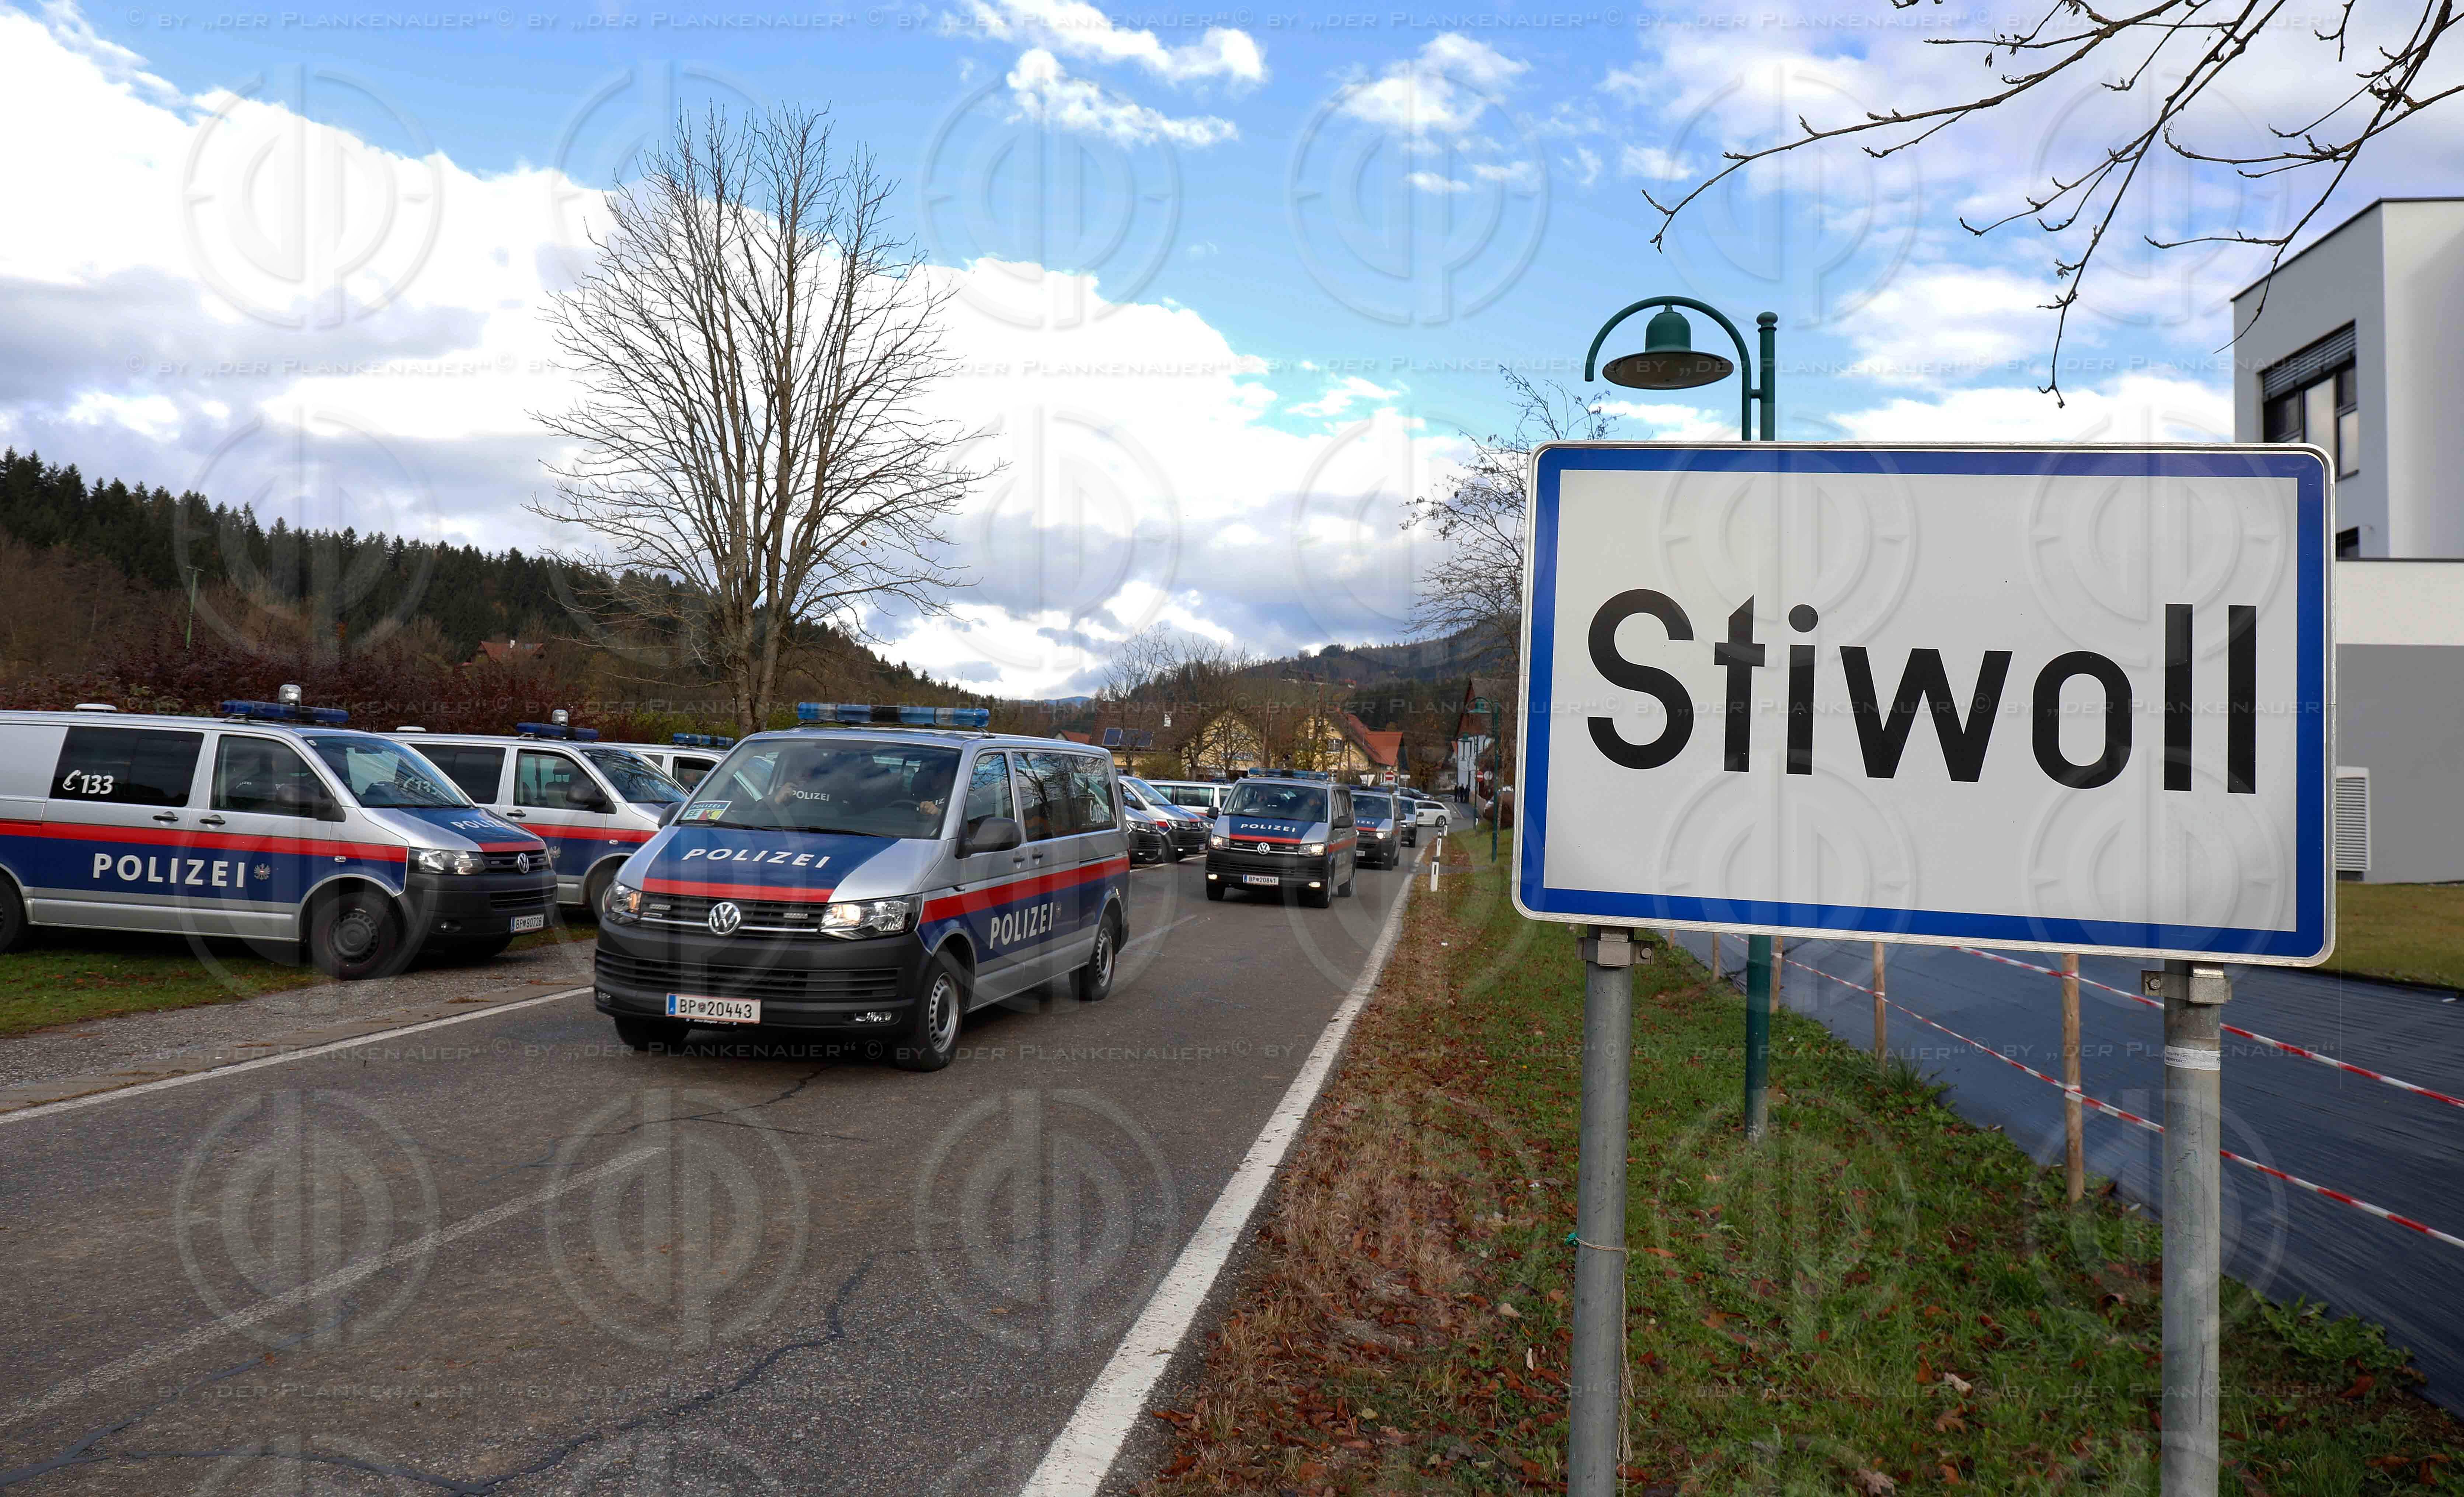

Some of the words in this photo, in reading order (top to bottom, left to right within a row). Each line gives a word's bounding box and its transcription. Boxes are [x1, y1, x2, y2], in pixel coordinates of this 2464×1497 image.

[1588, 589, 2256, 794] Stiwoll
[80, 774, 114, 795] 133
[792, 790, 830, 802] POLIZEI
[1240, 823, 1296, 833] POLIZEI
[682, 848, 831, 868] POLIZEI
[93, 853, 245, 888] POLIZEI
[989, 902, 1053, 949] POLIZEI
[680, 998, 696, 1014] BP
[707, 1001, 752, 1018] 20443
